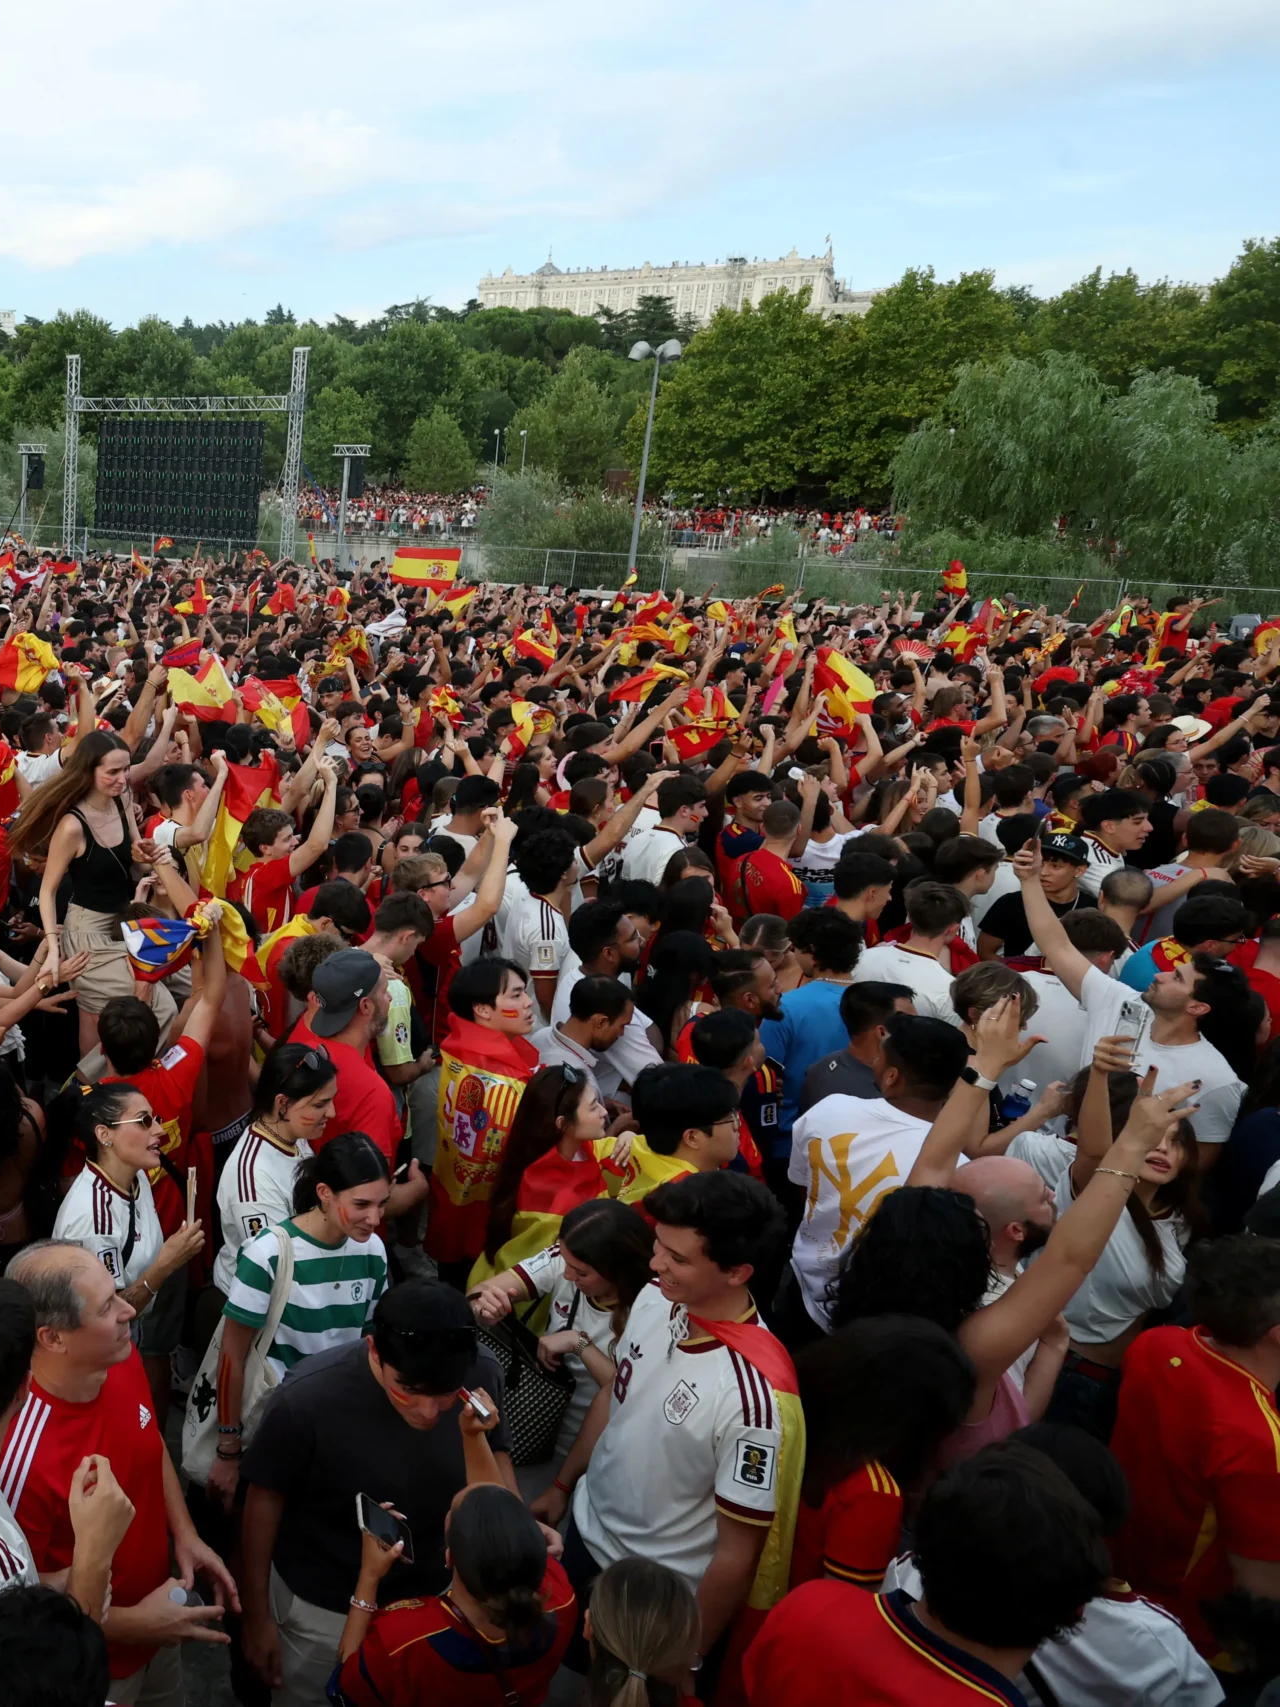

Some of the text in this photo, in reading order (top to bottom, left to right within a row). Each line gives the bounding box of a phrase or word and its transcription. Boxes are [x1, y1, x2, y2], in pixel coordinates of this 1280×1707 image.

[1052, 835, 1067, 847] NY
[212, 1123, 242, 1145] UNDER
[807, 1133, 901, 1249] NY
